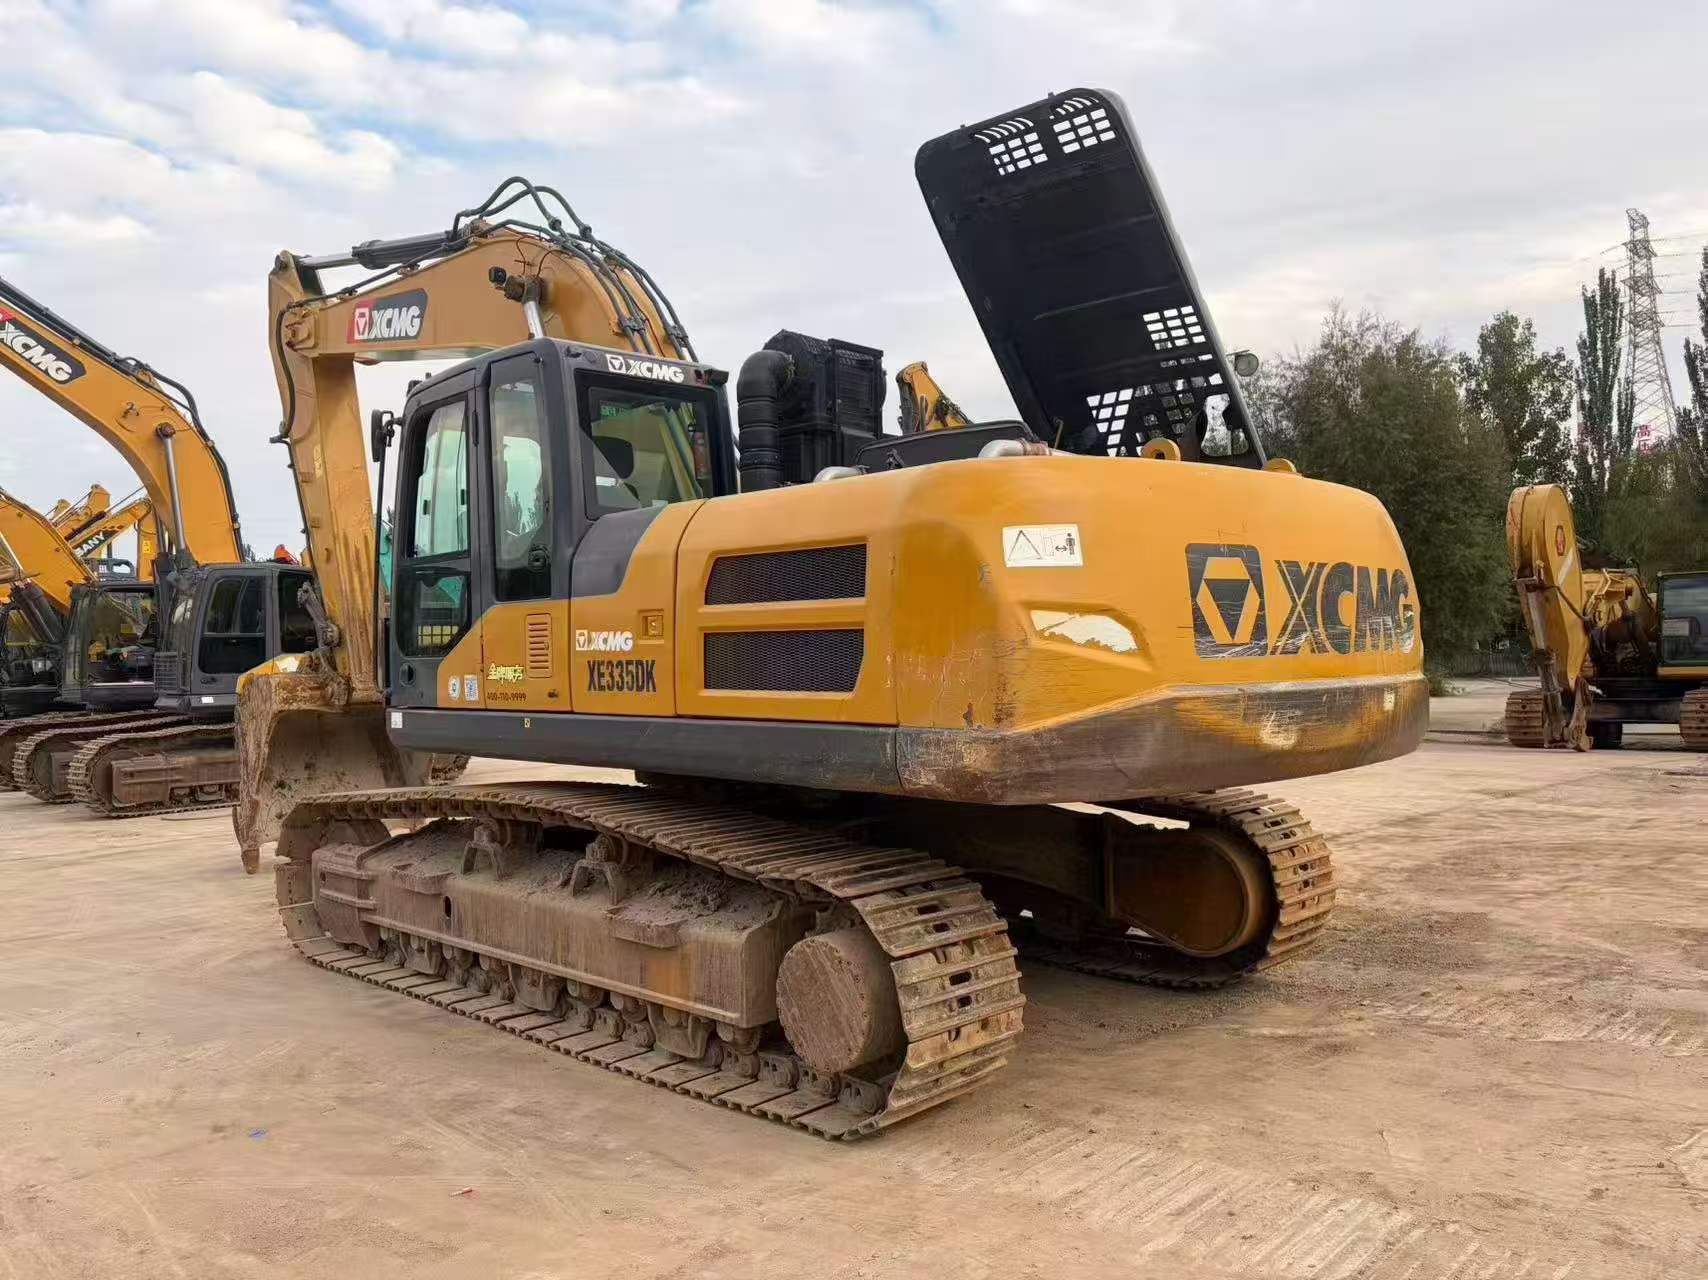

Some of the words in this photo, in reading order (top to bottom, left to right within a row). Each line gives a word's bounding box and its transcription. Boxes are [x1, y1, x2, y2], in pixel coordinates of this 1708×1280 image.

[368, 305, 421, 339] XCMG
[0, 321, 73, 382] XCMG
[626, 359, 685, 384] XCMG
[75, 531, 105, 558] SANY
[1270, 559, 1416, 656] XCMG
[588, 630, 633, 652] XCMG
[587, 659, 657, 692] XE335DK
